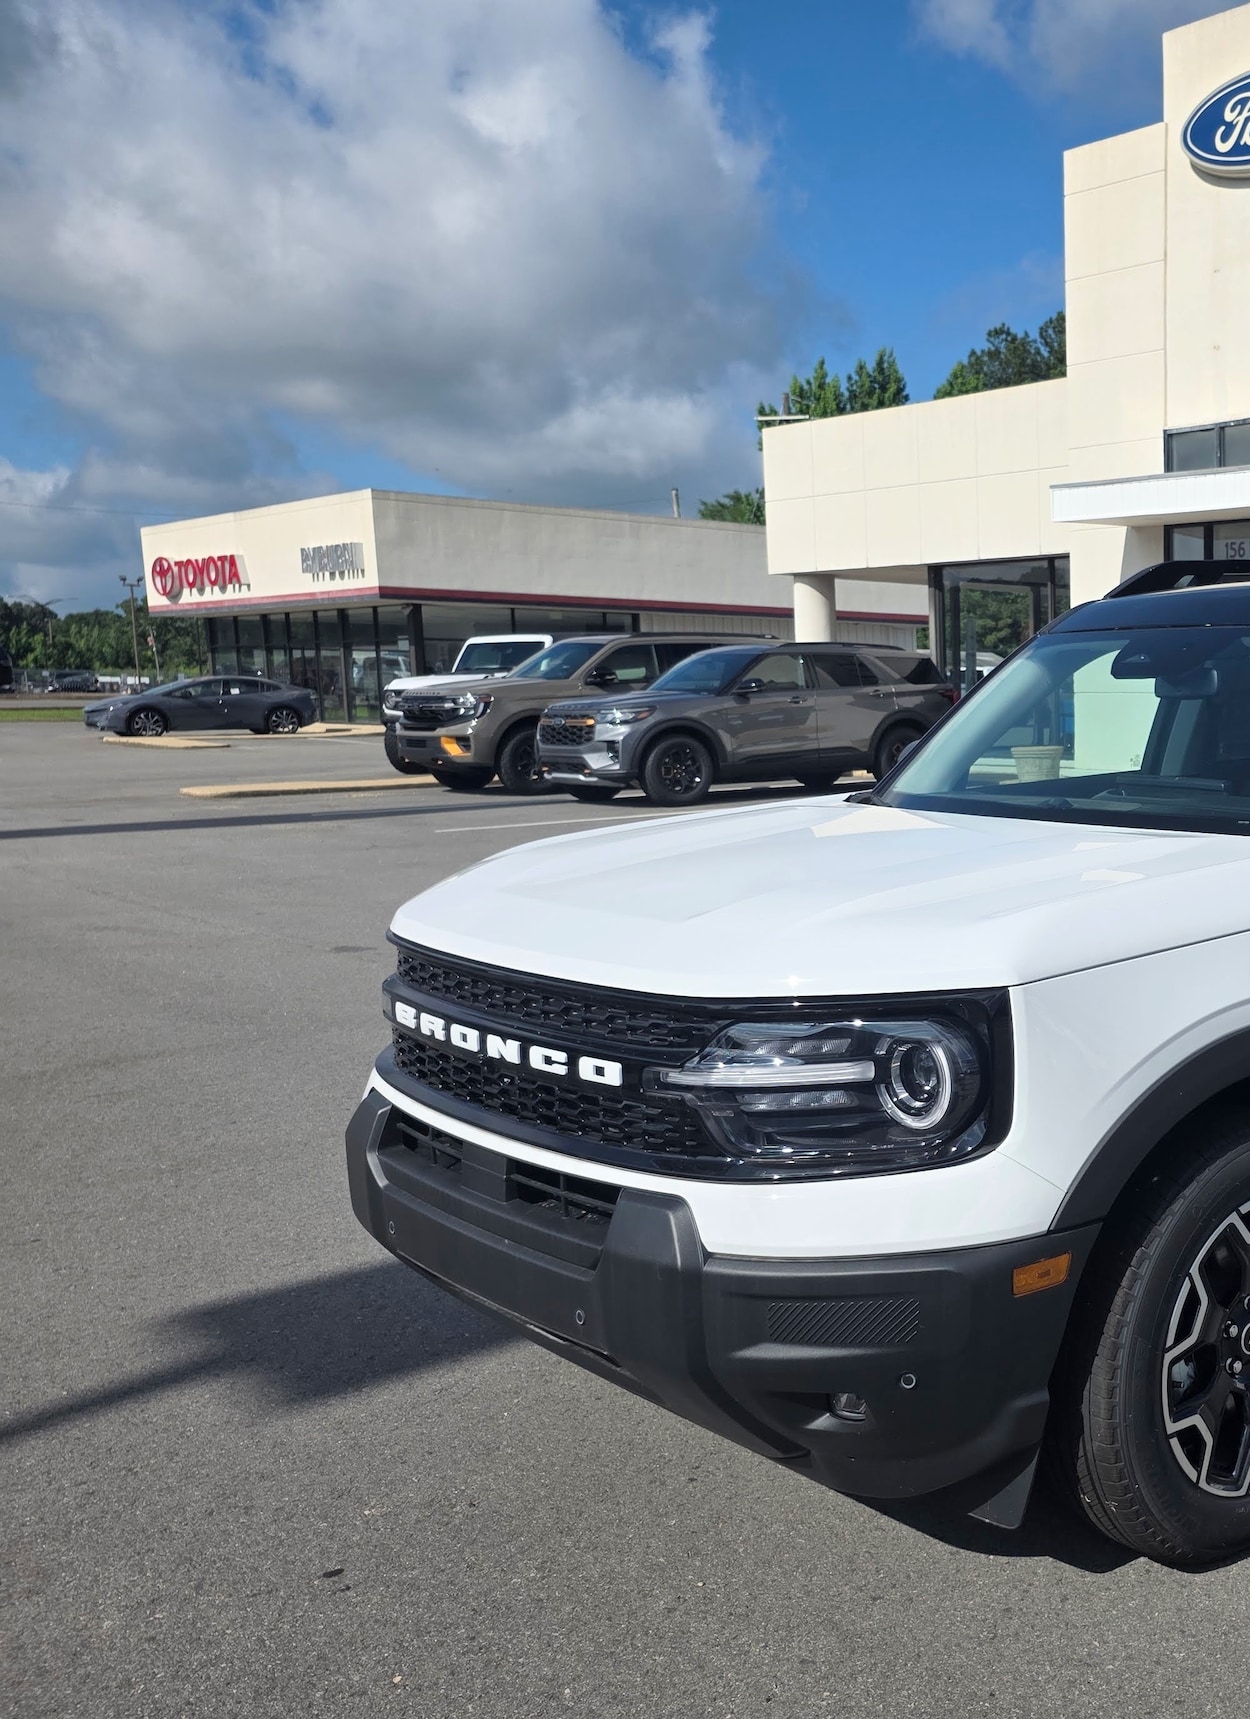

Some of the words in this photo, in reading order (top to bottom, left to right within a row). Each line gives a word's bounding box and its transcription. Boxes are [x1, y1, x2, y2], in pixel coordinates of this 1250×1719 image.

[1225, 542, 1246, 559] 156
[174, 554, 242, 589] TOYOTA
[395, 1002, 623, 1087] BRONCO
